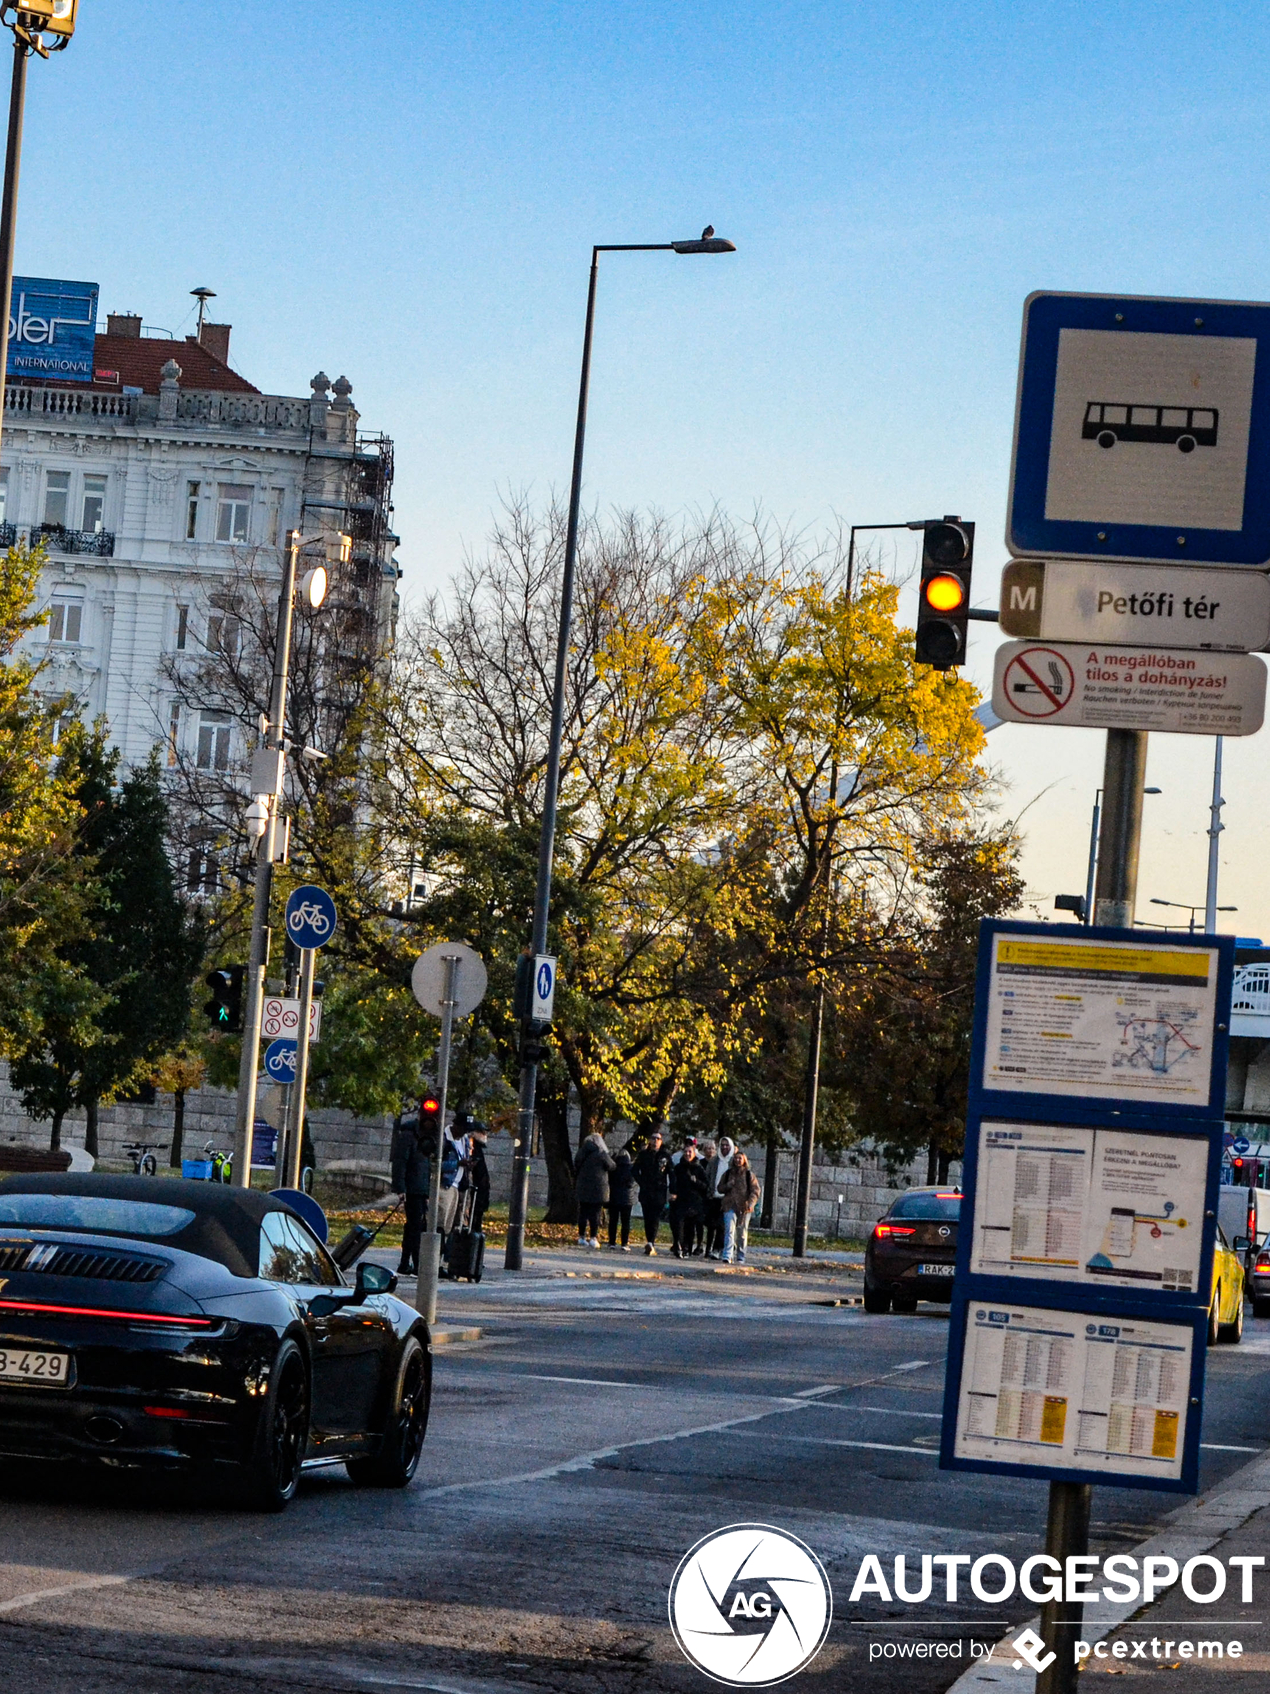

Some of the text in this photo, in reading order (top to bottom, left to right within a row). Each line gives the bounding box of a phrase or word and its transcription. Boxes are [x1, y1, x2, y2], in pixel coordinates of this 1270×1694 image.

[14, 357, 89, 372] INTERNATIONAL
[1009, 586, 1036, 611] M
[1097, 590, 1220, 620] Petőfi tér
[1086, 651, 1196, 670] A megállóban
[1085, 668, 1227, 690] tilos a dohányzás!
[1083, 684, 1096, 692] No
[1097, 685, 1132, 695] smoking
[1139, 687, 1186, 697] Interdiction
[1198, 692, 1224, 700] fumer
[1083, 694, 1118, 703] Rauchen
[1120, 697, 1156, 705] verboten
